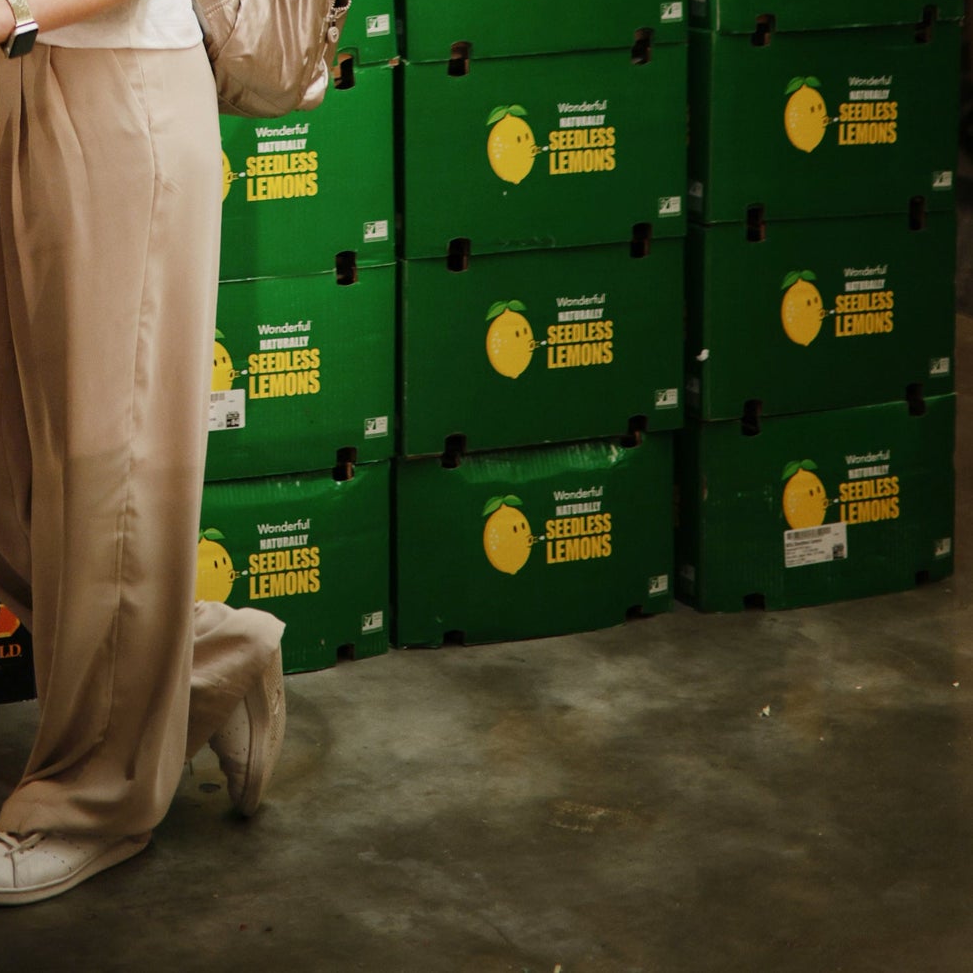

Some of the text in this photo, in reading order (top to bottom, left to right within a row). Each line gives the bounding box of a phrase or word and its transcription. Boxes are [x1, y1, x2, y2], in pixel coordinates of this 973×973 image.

[848, 75, 893, 87] Wonderful
[557, 99, 607, 113] Wonderful
[839, 101, 898, 123] SEEDLESS
[255, 123, 310, 138] Wonderful
[548, 126, 616, 151] SEEDLESS
[838, 120, 898, 146] LEMONS
[257, 138, 307, 153] NATURALLY
[245, 151, 318, 177] SEEDLESS
[549, 147, 616, 175] LEMONS
[246, 172, 318, 202] LEMONS
[843, 265, 887, 277] Wonderful
[556, 292, 606, 307] Wonderful
[835, 290, 894, 314] SEEDLESS
[257, 320, 311, 335] Wonderful
[547, 320, 613, 345] SEEDLESS
[835, 310, 894, 337] LEMONS
[259, 336, 309, 351] NATURALLY
[547, 340, 613, 368] LEMONS
[247, 348, 320, 375] SEEDLESS
[248, 369, 321, 400] LEMONS
[845, 449, 891, 465] Wonderful
[553, 486, 604, 501] Wonderful
[839, 475, 900, 503] SEEDLESS
[840, 496, 900, 525] LEMONS
[256, 518, 311, 534] Wonderful
[546, 513, 612, 540] SEEDLESS
[259, 534, 309, 550] NATURALLY
[546, 533, 612, 564] LEMONS
[248, 546, 320, 575] SEEDLESS
[249, 568, 321, 600] LEMONS
